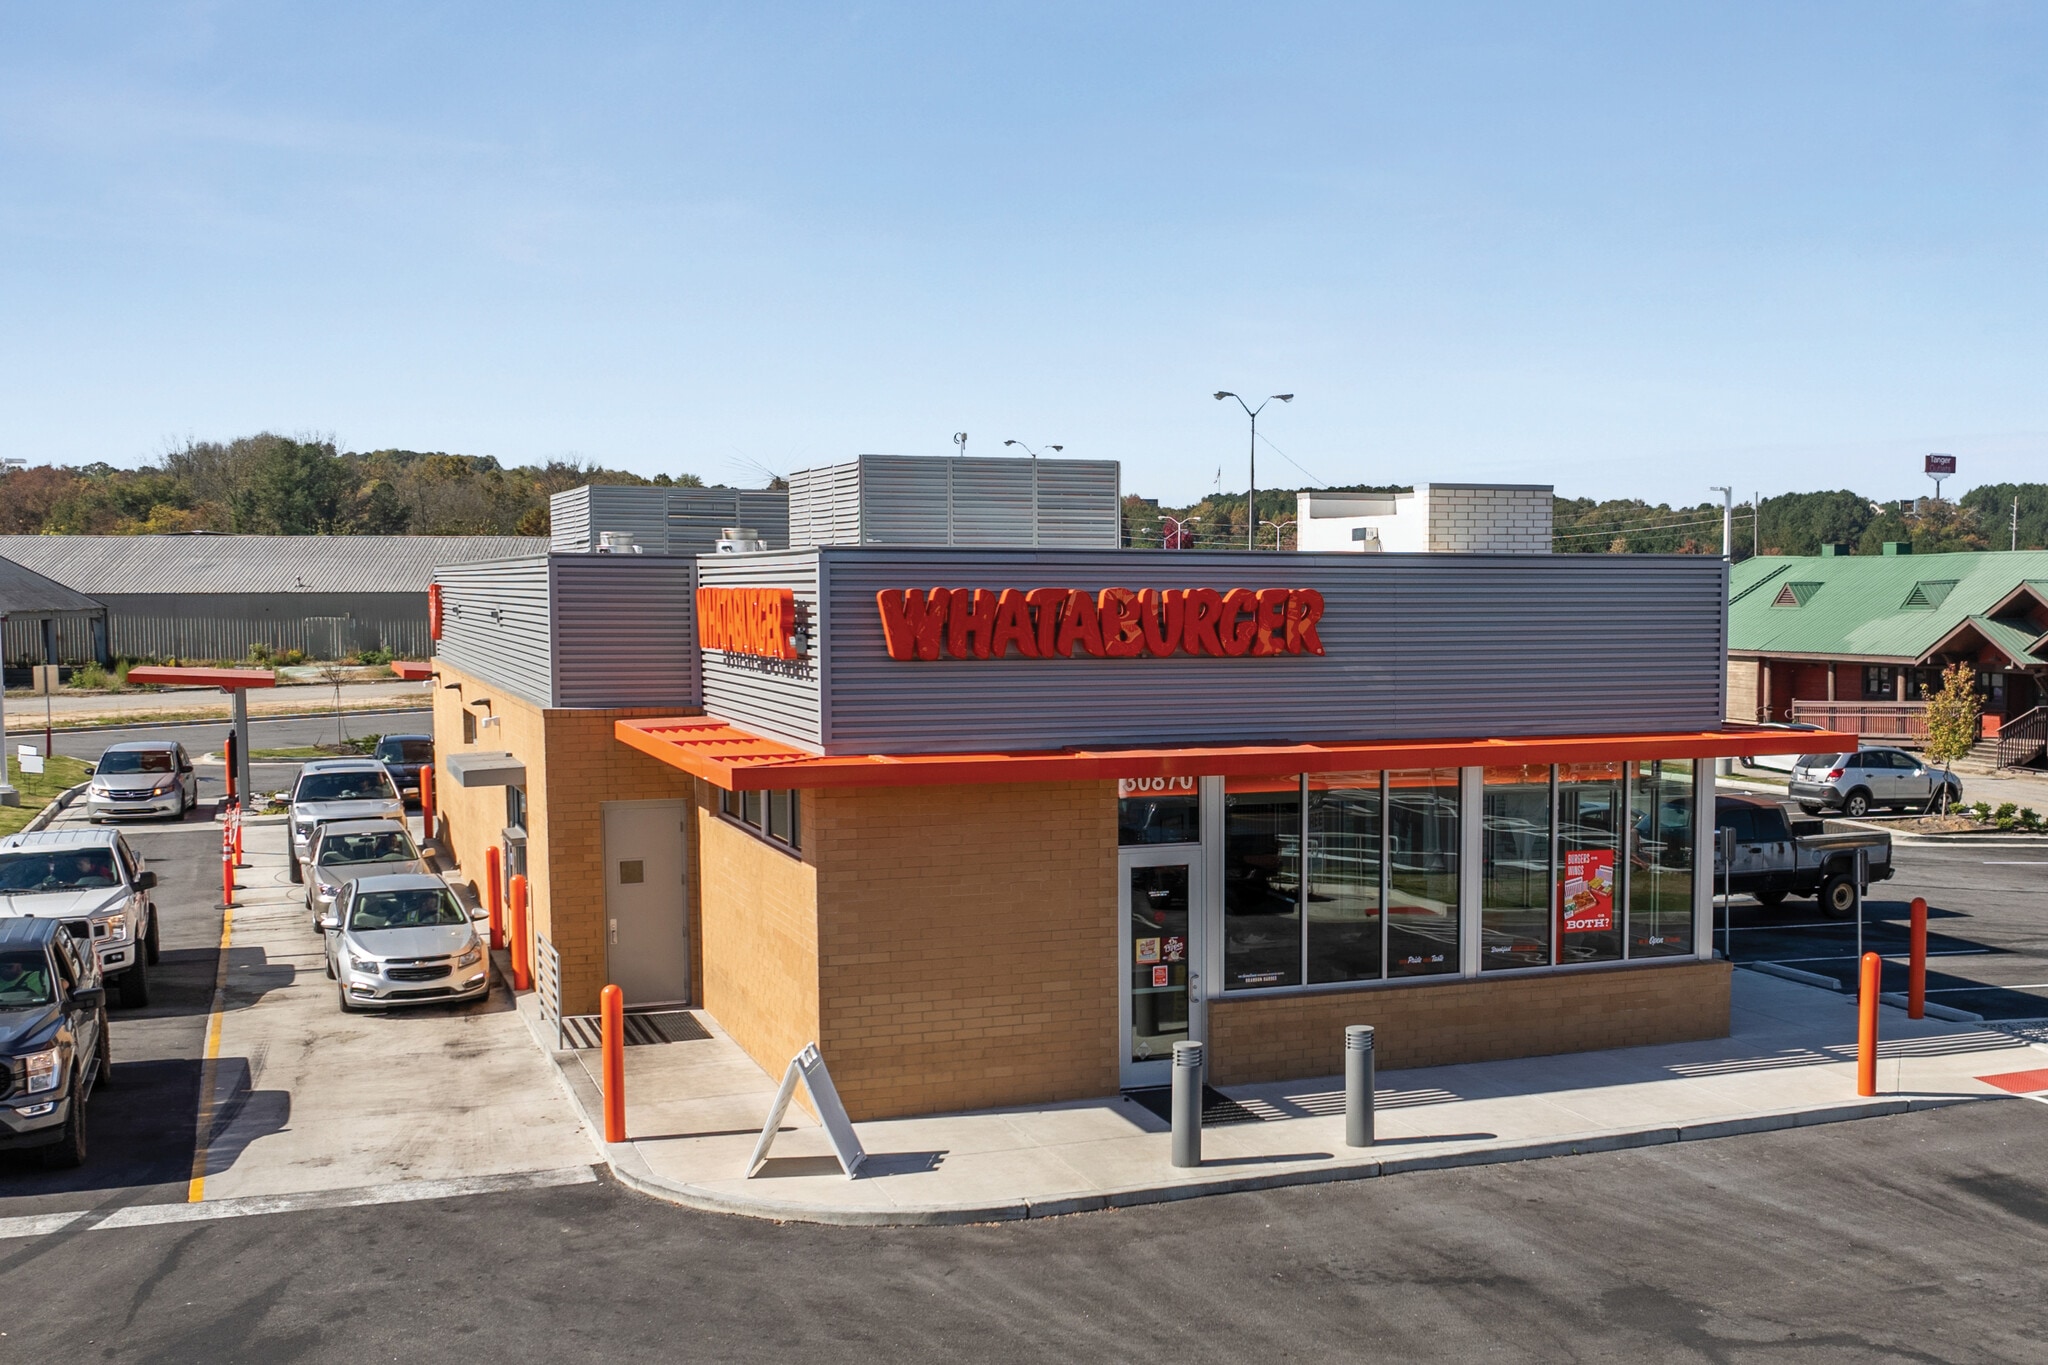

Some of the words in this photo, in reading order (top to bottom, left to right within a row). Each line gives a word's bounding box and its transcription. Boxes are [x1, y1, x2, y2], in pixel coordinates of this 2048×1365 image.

[1930, 455, 1951, 466] Tanger
[877, 587, 1325, 660] WHATABURGER
[1568, 853, 1590, 865] BURGERS
[1568, 865, 1584, 876] WINGS
[1566, 918, 1610, 930] BOTH?
